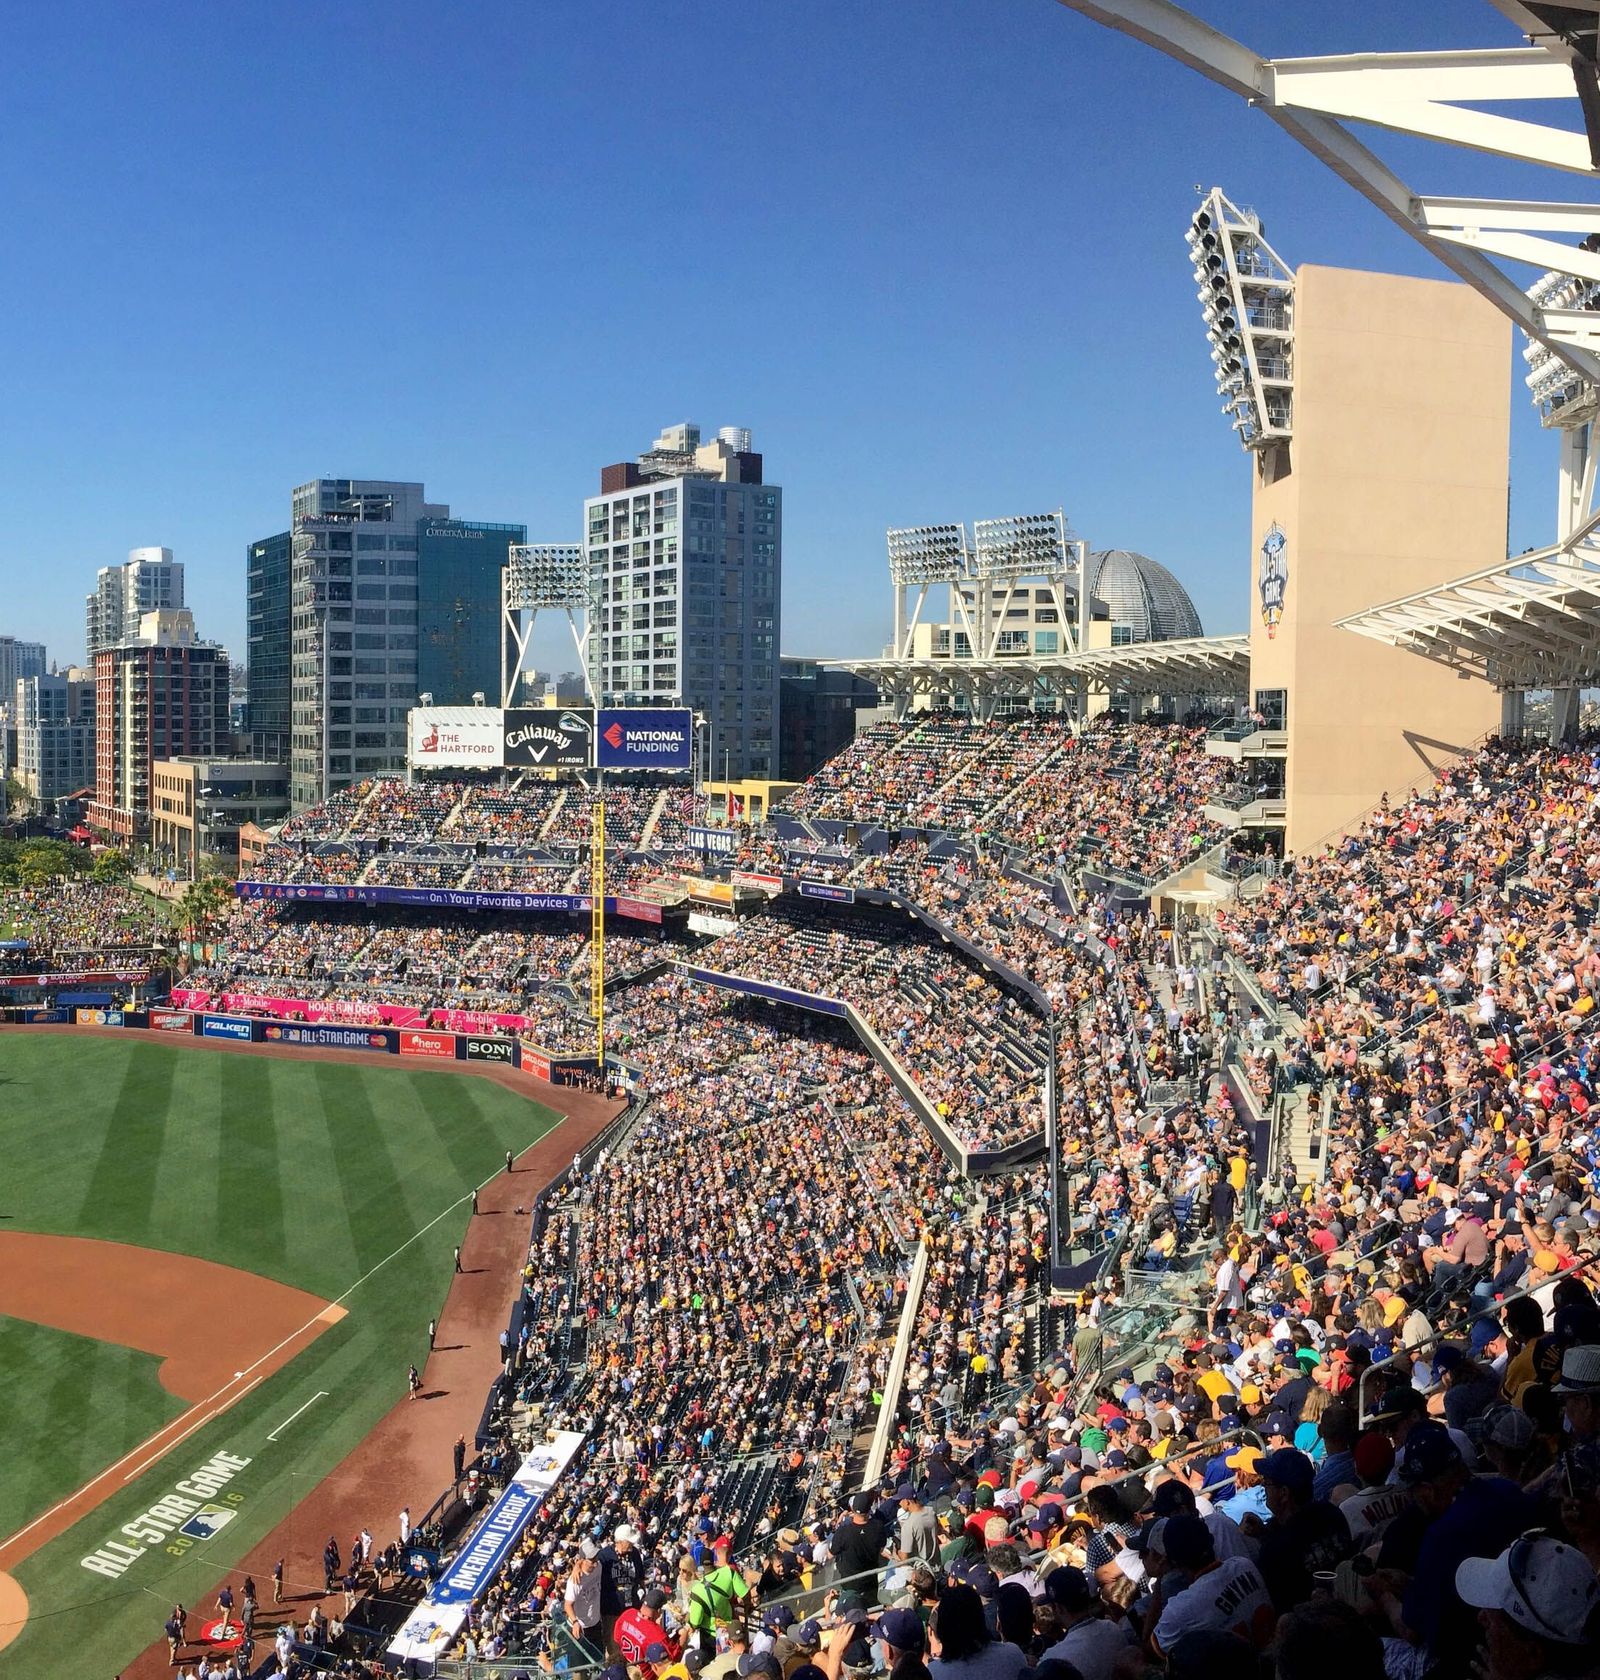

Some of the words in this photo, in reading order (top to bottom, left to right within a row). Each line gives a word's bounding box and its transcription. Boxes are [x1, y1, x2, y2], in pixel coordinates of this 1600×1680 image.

[506, 724, 572, 750] Callaway
[626, 731, 684, 741] NATIONAL
[441, 745, 494, 753] HARTFORD
[626, 743, 679, 753] FUNDING
[690, 831, 704, 849] LAS
[707, 833, 731, 851] VEGAS
[430, 893, 442, 903] On
[449, 893, 473, 905] Your
[476, 894, 521, 907] Favorite
[525, 896, 568, 909] Devices
[308, 1002, 335, 1012] HOME
[355, 1003, 379, 1014] DECK
[205, 1021, 249, 1032] FALKEN
[343, 1031, 369, 1045] GAME
[419, 1038, 440, 1049] hero
[468, 1042, 512, 1057] SONY
[175, 1450, 253, 1499] GAME
[1361, 1494, 1408, 1527] MOLIN
[448, 1528, 505, 1591] AMERICAN
[494, 1493, 530, 1531] LEAGUE
[1215, 1571, 1258, 1616] GWYNN
